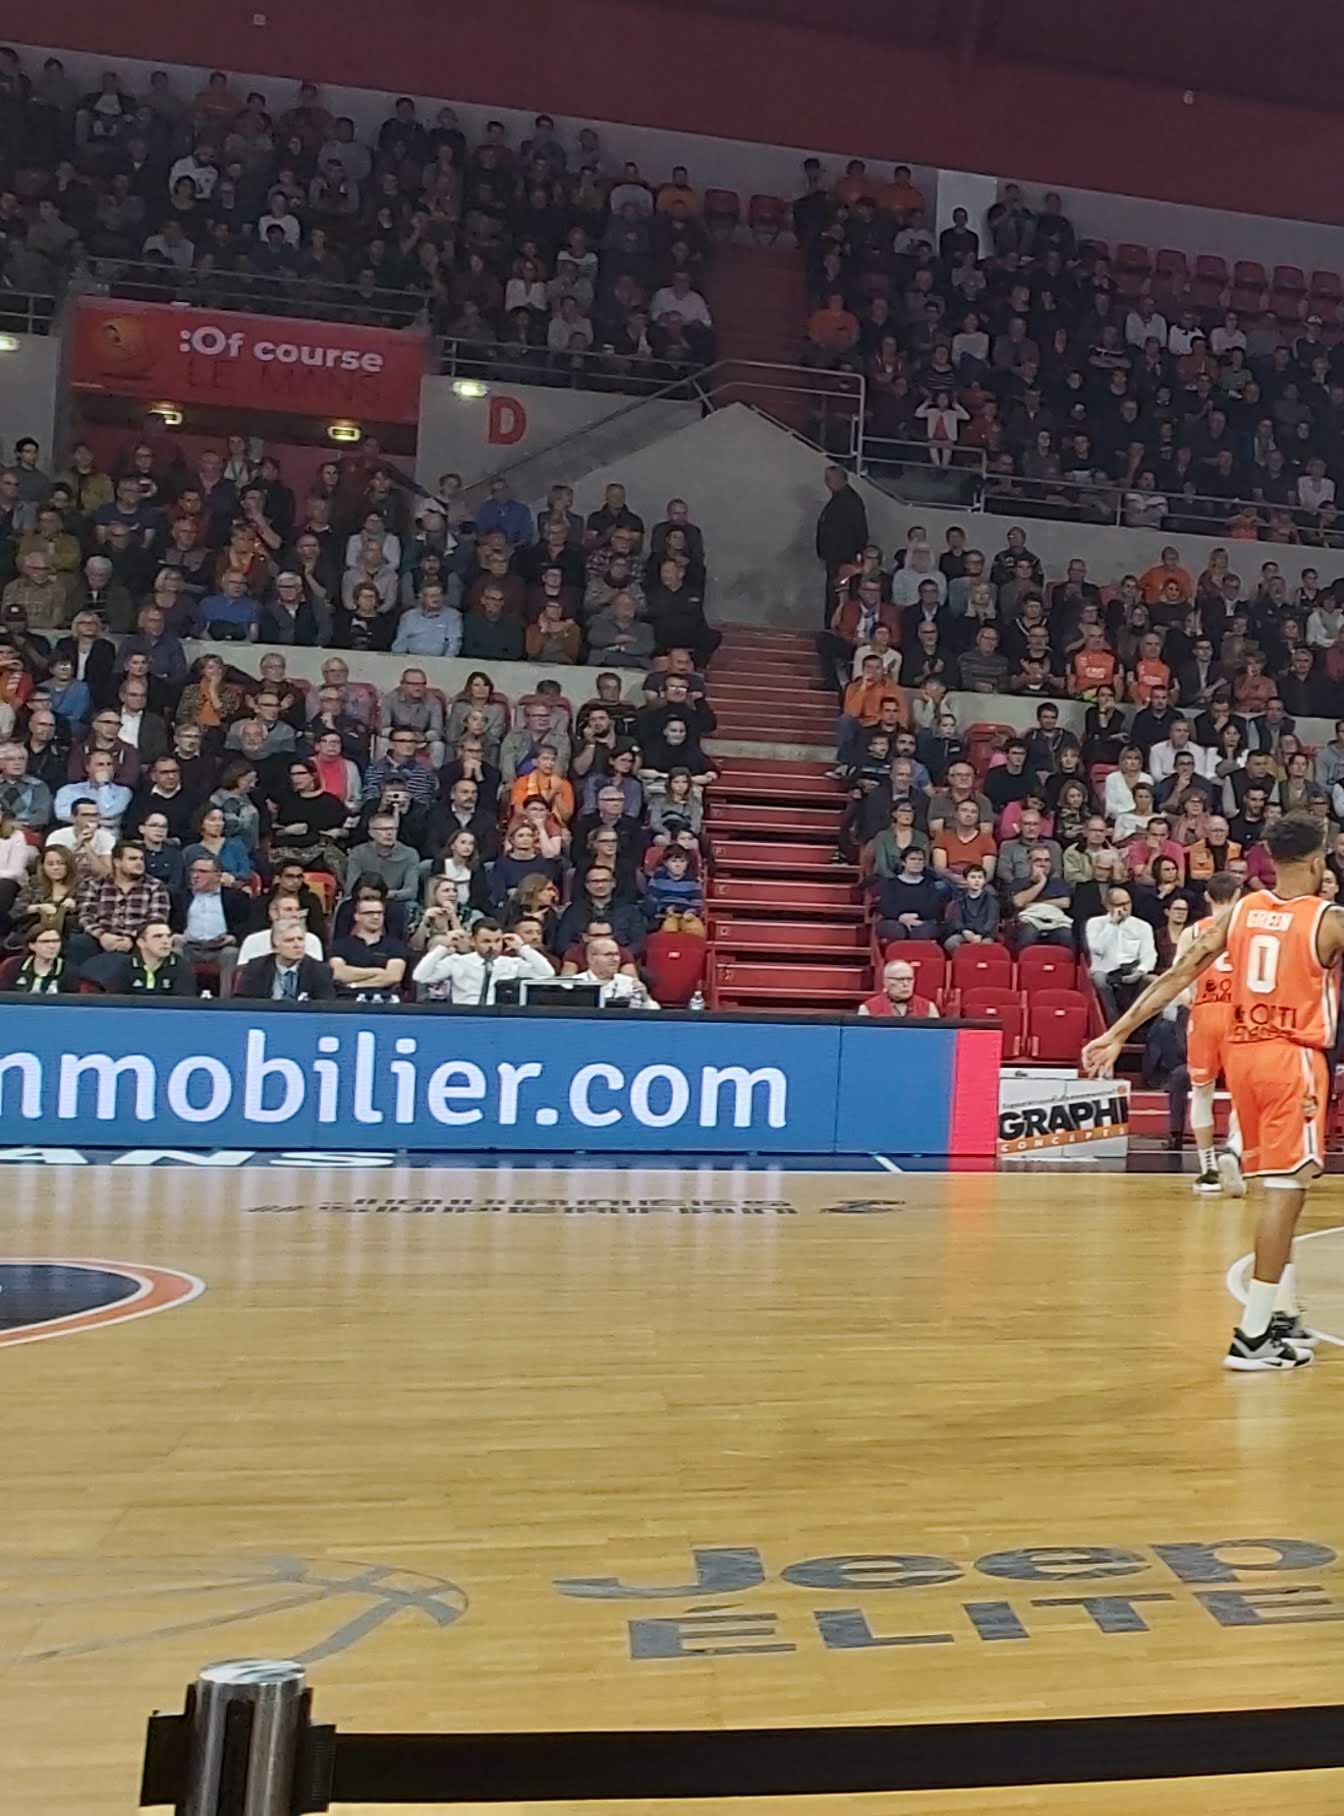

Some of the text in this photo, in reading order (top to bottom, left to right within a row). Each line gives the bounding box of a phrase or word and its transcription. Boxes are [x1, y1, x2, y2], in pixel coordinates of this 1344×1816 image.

[253, 340, 384, 373] course
[488, 395, 527, 446] D
[1247, 934, 1280, 994] 0
[552, 1537, 1340, 1600] Jeep
